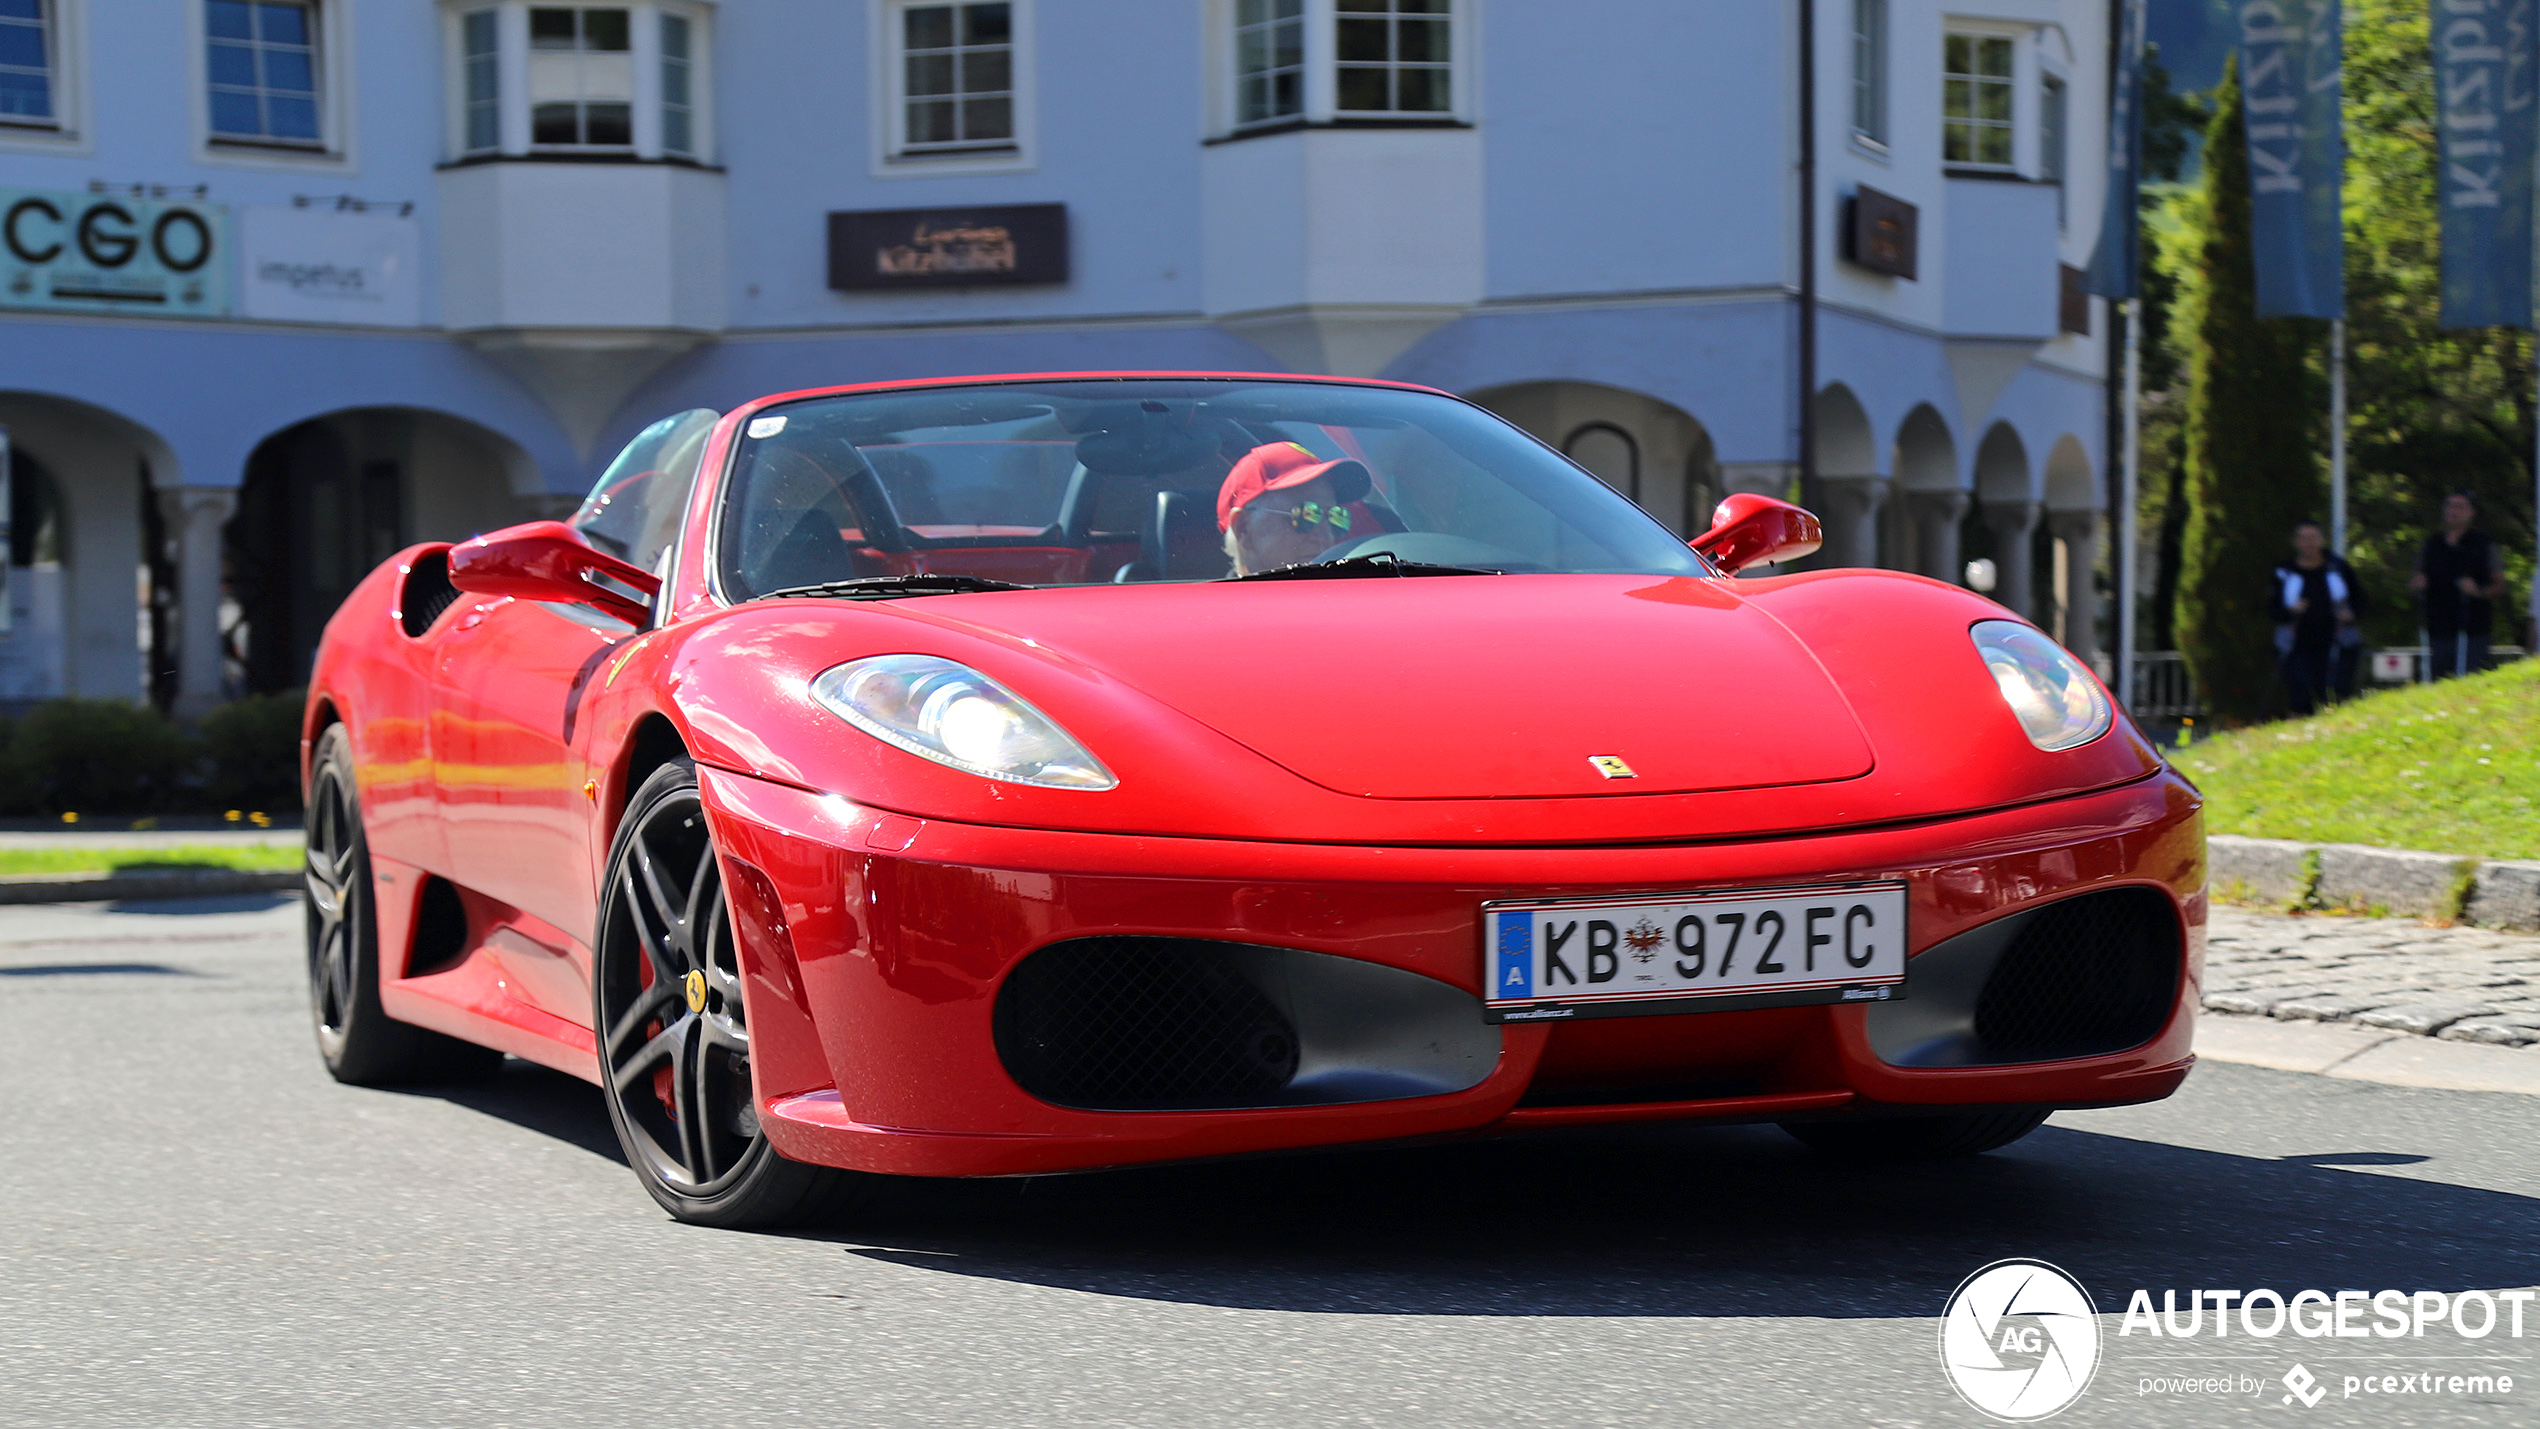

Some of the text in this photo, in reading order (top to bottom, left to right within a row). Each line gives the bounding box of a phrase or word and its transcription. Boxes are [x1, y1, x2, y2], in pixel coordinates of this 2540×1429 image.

[4, 197, 213, 273] CGO
[1505, 966, 1525, 987] A
[1545, 904, 1874, 986] KB 972 FC
